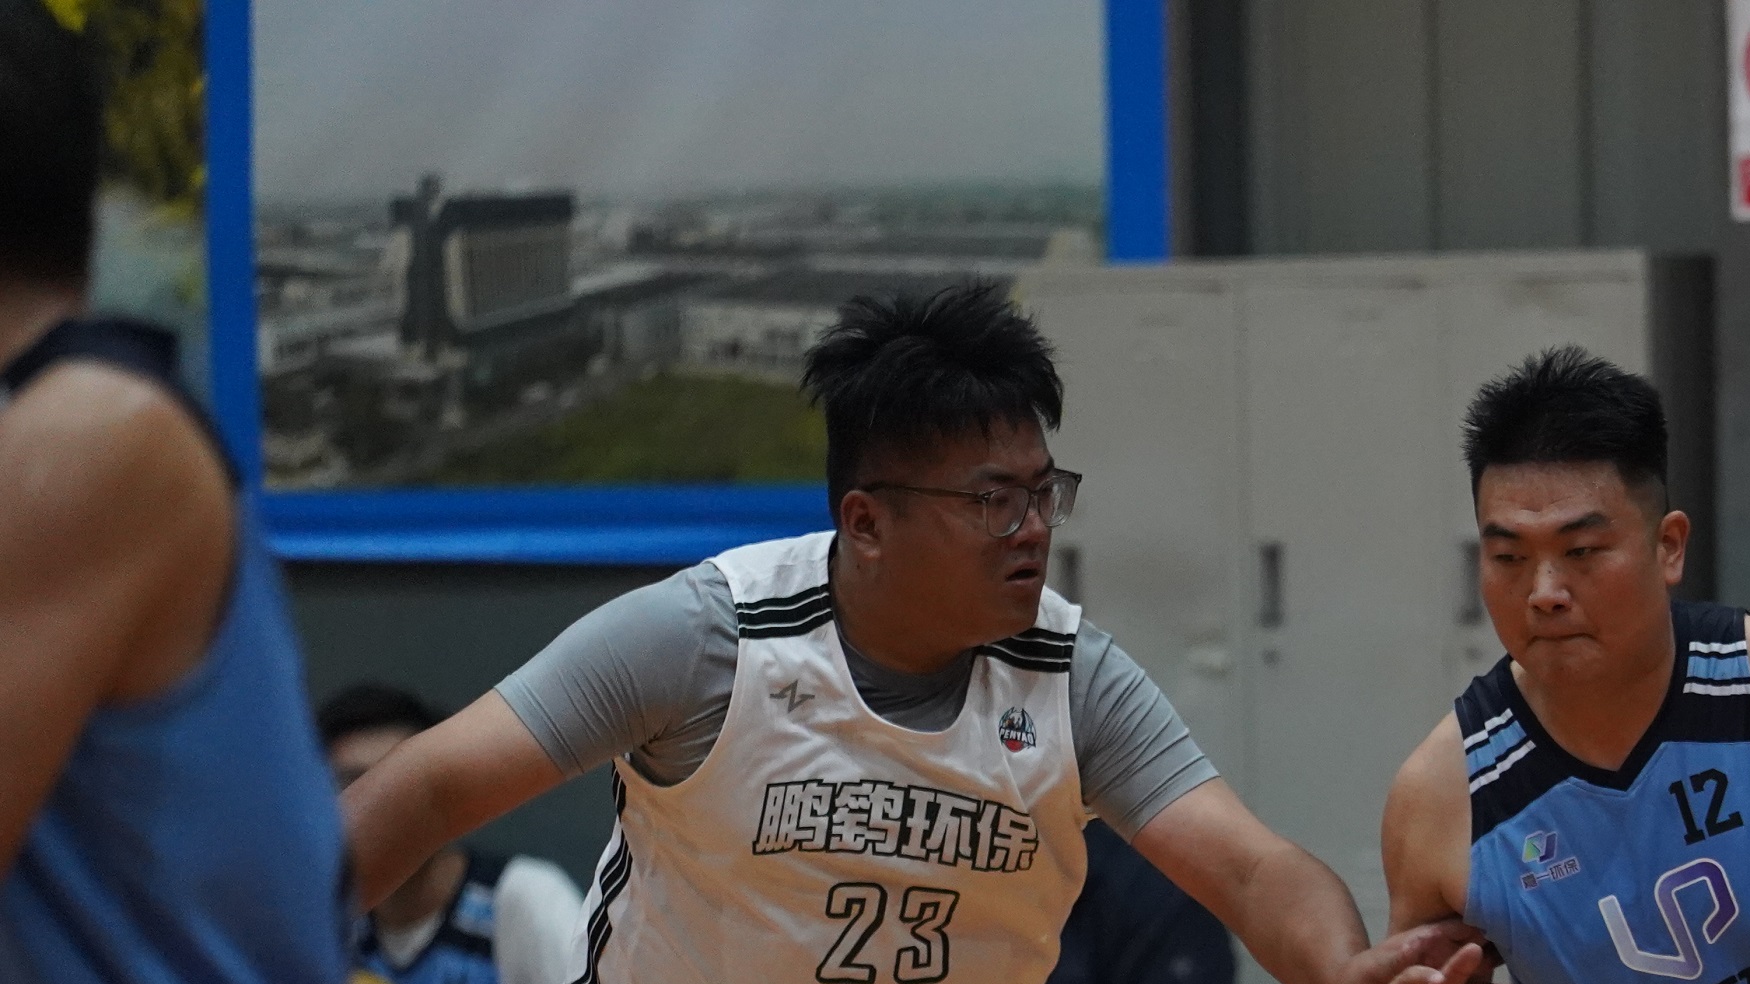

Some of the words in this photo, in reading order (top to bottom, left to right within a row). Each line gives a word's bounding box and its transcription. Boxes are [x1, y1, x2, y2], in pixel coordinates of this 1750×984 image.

[752, 779, 1039, 873] 鹏鹞环保
[1668, 768, 1744, 846] 12
